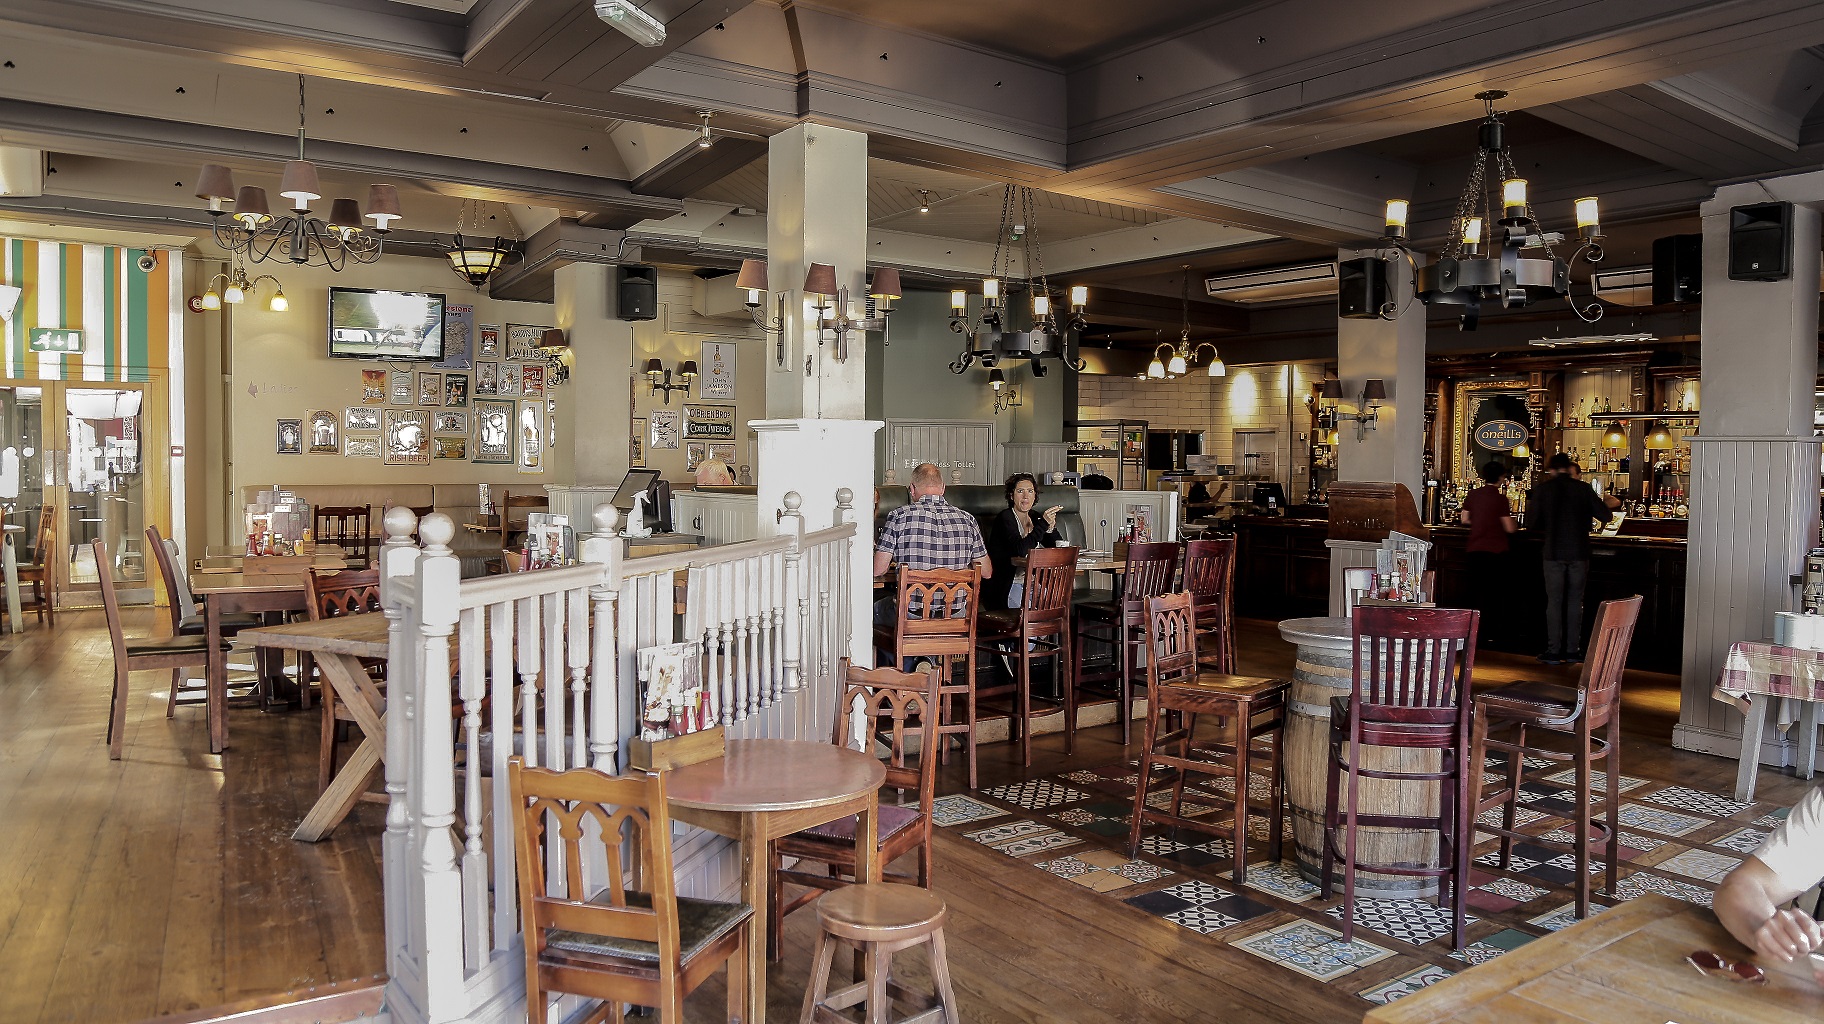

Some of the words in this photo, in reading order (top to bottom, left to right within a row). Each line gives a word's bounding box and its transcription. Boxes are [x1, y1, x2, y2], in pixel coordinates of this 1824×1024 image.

[446, 305, 472, 313] estone
[512, 348, 548, 358] WHISK
[388, 410, 428, 424] KILKENNY
[689, 408, 715, 418] O'BRIEN
[388, 454, 407, 462] IRISH
[408, 454, 428, 463] BEER
[927, 460, 951, 469] Acess
[953, 460, 976, 469] Toilet
